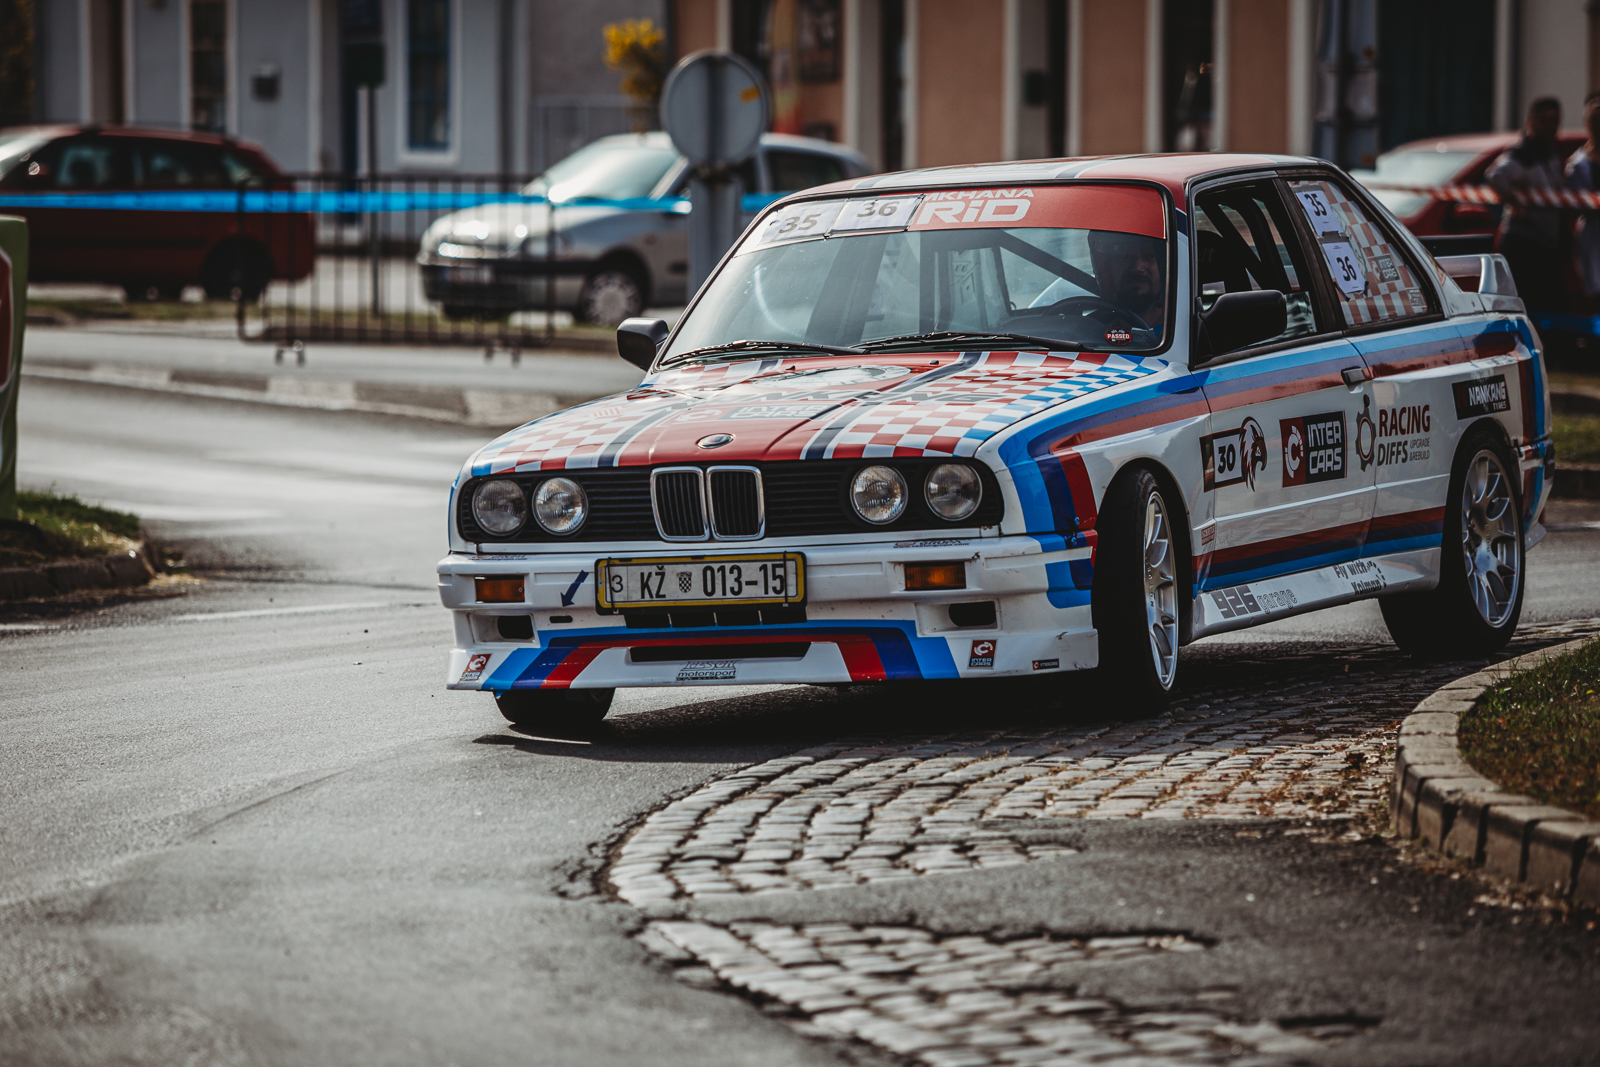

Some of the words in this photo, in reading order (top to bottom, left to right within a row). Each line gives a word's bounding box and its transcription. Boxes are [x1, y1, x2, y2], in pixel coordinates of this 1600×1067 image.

[924, 189, 1035, 202] MKHANA
[1304, 193, 1328, 217] 35
[856, 200, 900, 218] 36
[915, 198, 1031, 225] RiD
[779, 213, 822, 234] 35
[1336, 256, 1357, 282] 36
[1468, 381, 1507, 407] NANKANG
[1492, 401, 1507, 411] TYRES
[729, 411, 819, 419] CARS
[738, 404, 829, 412] INTER
[1378, 404, 1431, 438] RACING
[1307, 420, 1342, 448] INTER
[1410, 438, 1430, 449] UPGRADE
[1217, 443, 1236, 474] 30
[1309, 447, 1342, 475] CARS
[1377, 440, 1408, 467] DIFFS
[611, 574, 624, 593] 3
[639, 565, 667, 600] KŽ
[702, 563, 785, 597] 013-15
[1332, 563, 1349, 580] Fly
[1346, 559, 1368, 576] with
[1209, 584, 1262, 619] 926
[1256, 588, 1298, 614] garage
[677, 670, 737, 680] motorsport
